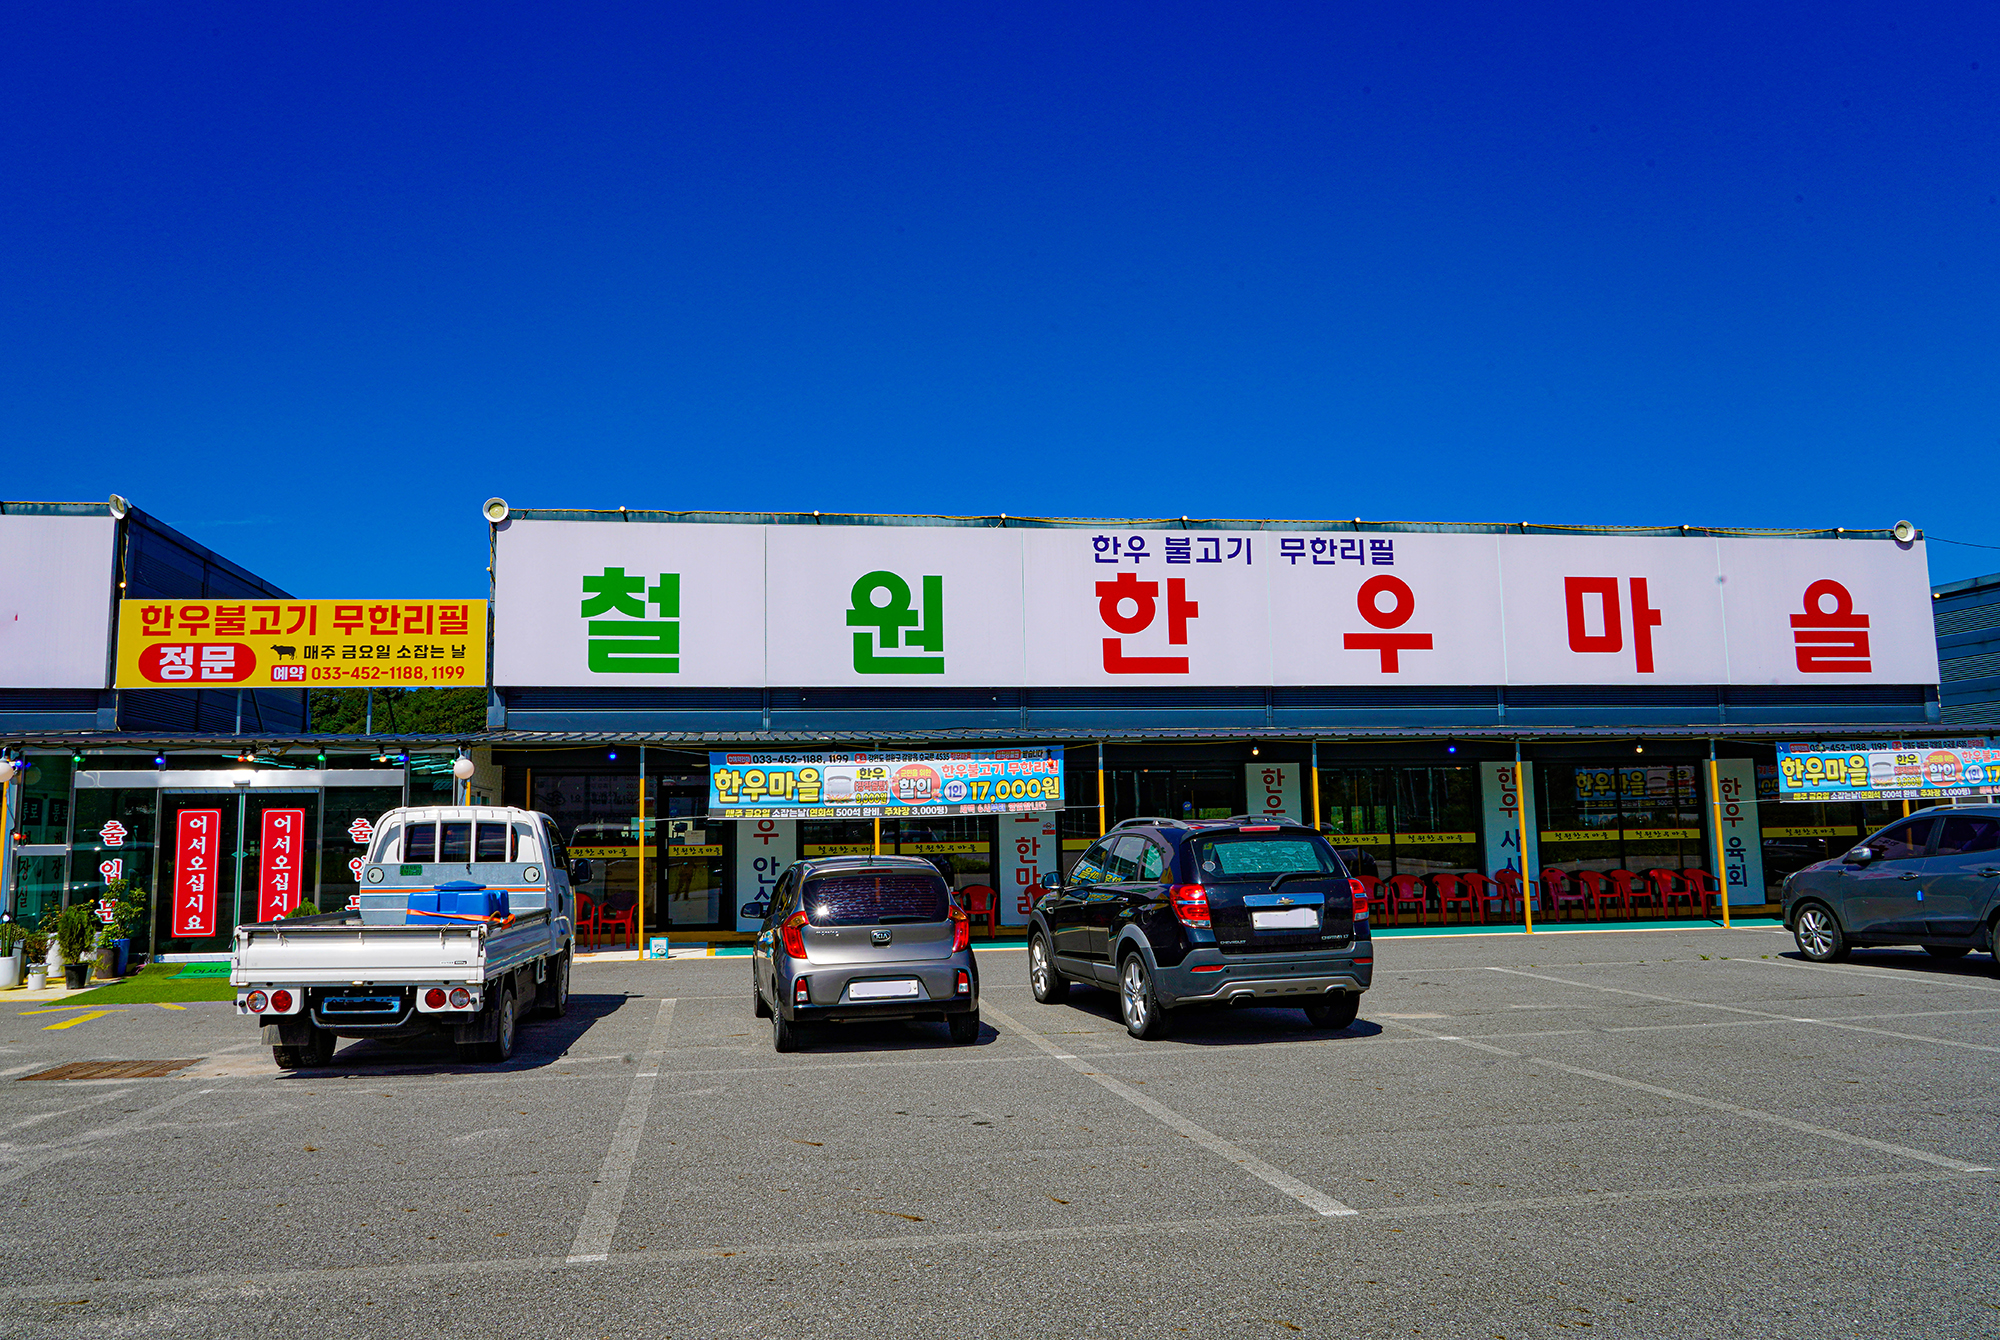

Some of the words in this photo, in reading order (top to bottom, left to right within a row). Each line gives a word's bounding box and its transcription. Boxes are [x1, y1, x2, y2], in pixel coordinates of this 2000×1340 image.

[1092, 534, 1150, 564] 한우
[1165, 536, 1252, 565] 불고기
[1280, 537, 1395, 566] 무한리필
[140, 605, 317, 637] 한우불고기
[333, 605, 468, 636] 무한리필
[303, 645, 336, 660] 매주
[342, 645, 391, 660] 금요일
[396, 644, 446, 660] 소잡는
[451, 644, 467, 660] 날
[159, 646, 235, 680] 정문
[273, 666, 305, 681] 예약
[311, 666, 428, 682] 033-452-1188,
[431, 666, 466, 680] 1199
[752, 754, 826, 765] 033-452-1188,
[829, 754, 849, 764] 1199
[1896, 754, 1918, 766] 한우
[859, 767, 885, 780] 한우
[919, 768, 932, 778] 위한
[941, 762, 1005, 779] 한우불고기
[1007, 759, 1059, 775] 무한리필
[1780, 755, 1868, 788] 한우마을
[1929, 763, 1957, 782] 할인
[1967, 767, 1981, 780] 1인
[713, 768, 822, 805] 한우마을
[899, 778, 932, 800] 할인
[948, 785, 962, 798] 1인
[969, 776, 1061, 803] 17,000원
[1261, 768, 1286, 820] 한우
[1496, 766, 1520, 818] 한우
[855, 792, 888, 806] 9,000원
[1719, 778, 1744, 828] 한우
[725, 808, 743, 818] 매주
[744, 808, 771, 818] 금요일
[836, 808, 860, 817] 500석
[884, 807, 911, 816] 주차장
[1408, 834, 1464, 843] 철원한우마을
[1555, 832, 1609, 841] 철원한우마을
[1635, 830, 1689, 839] 철원한우마을
[1785, 828, 1836, 836] 철원한우마을
[673, 847, 721, 856] 철원한우마을
[818, 845, 876, 854] 철원한우마
[915, 844, 977, 853] 철원한우마을
[1725, 836, 1748, 888] 육회
[184, 815, 208, 931] 어서오십시요
